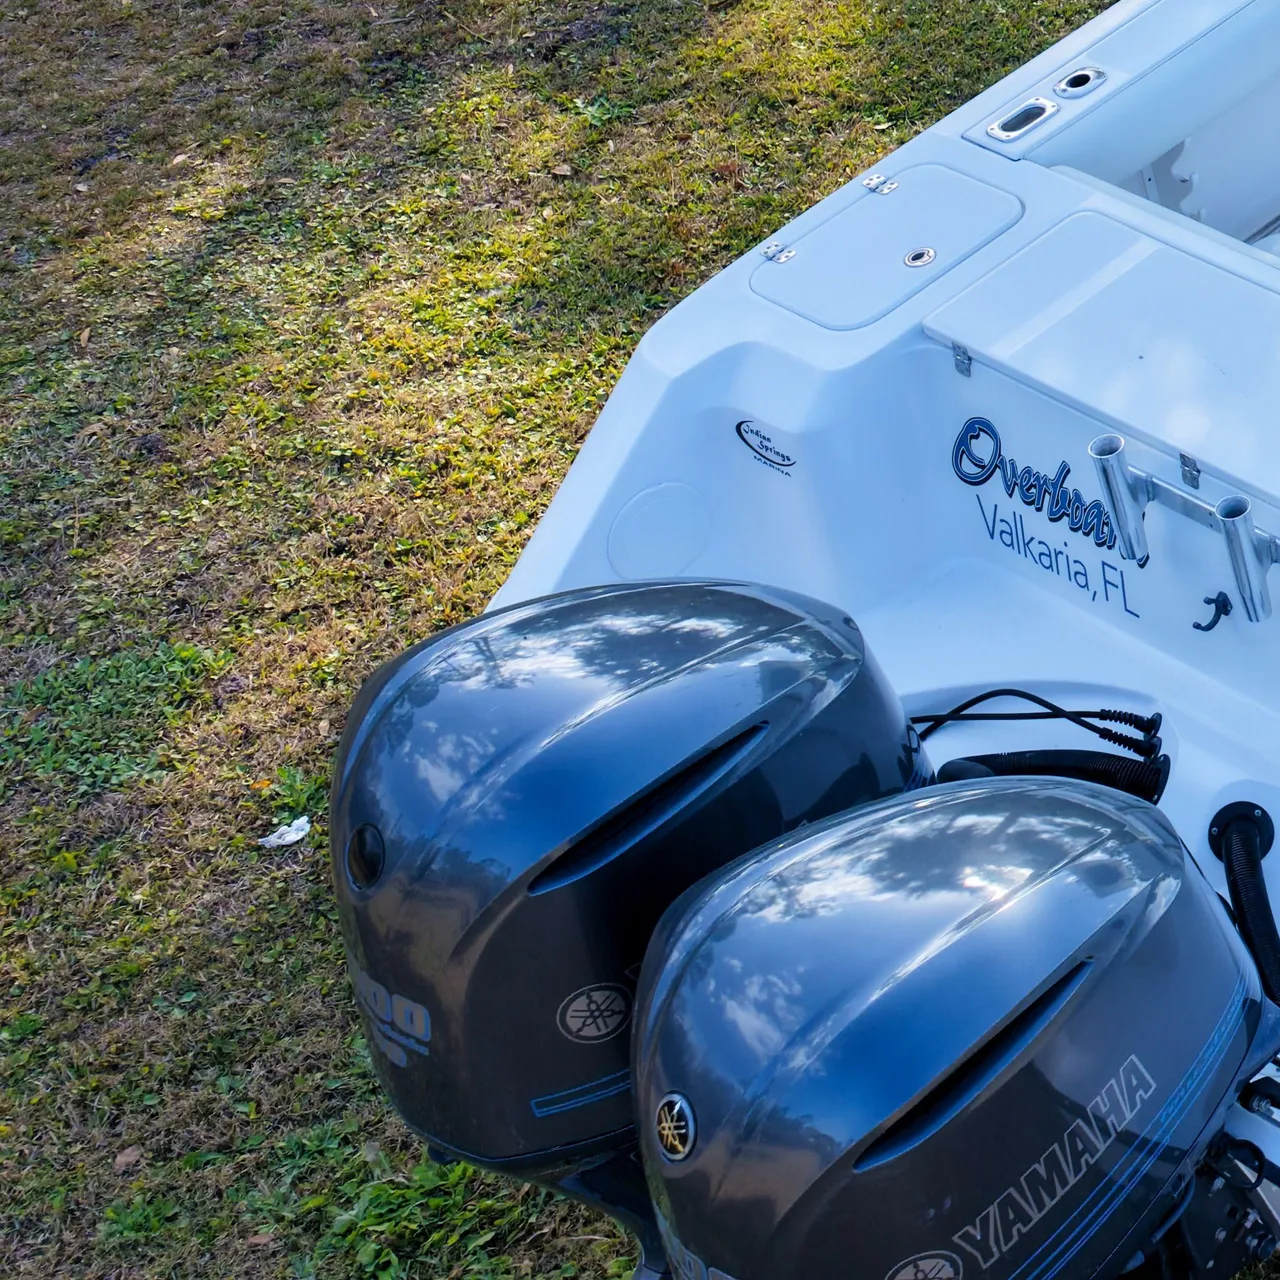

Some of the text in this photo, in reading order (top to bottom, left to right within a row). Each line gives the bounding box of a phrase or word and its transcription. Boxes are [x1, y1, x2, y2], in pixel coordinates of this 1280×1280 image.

[742, 423, 772, 443] Indian
[756, 440, 791, 462] Springs
[976, 493, 1141, 619] Valkaria, FL
[951, 1053, 1157, 1270] YAMAHA
